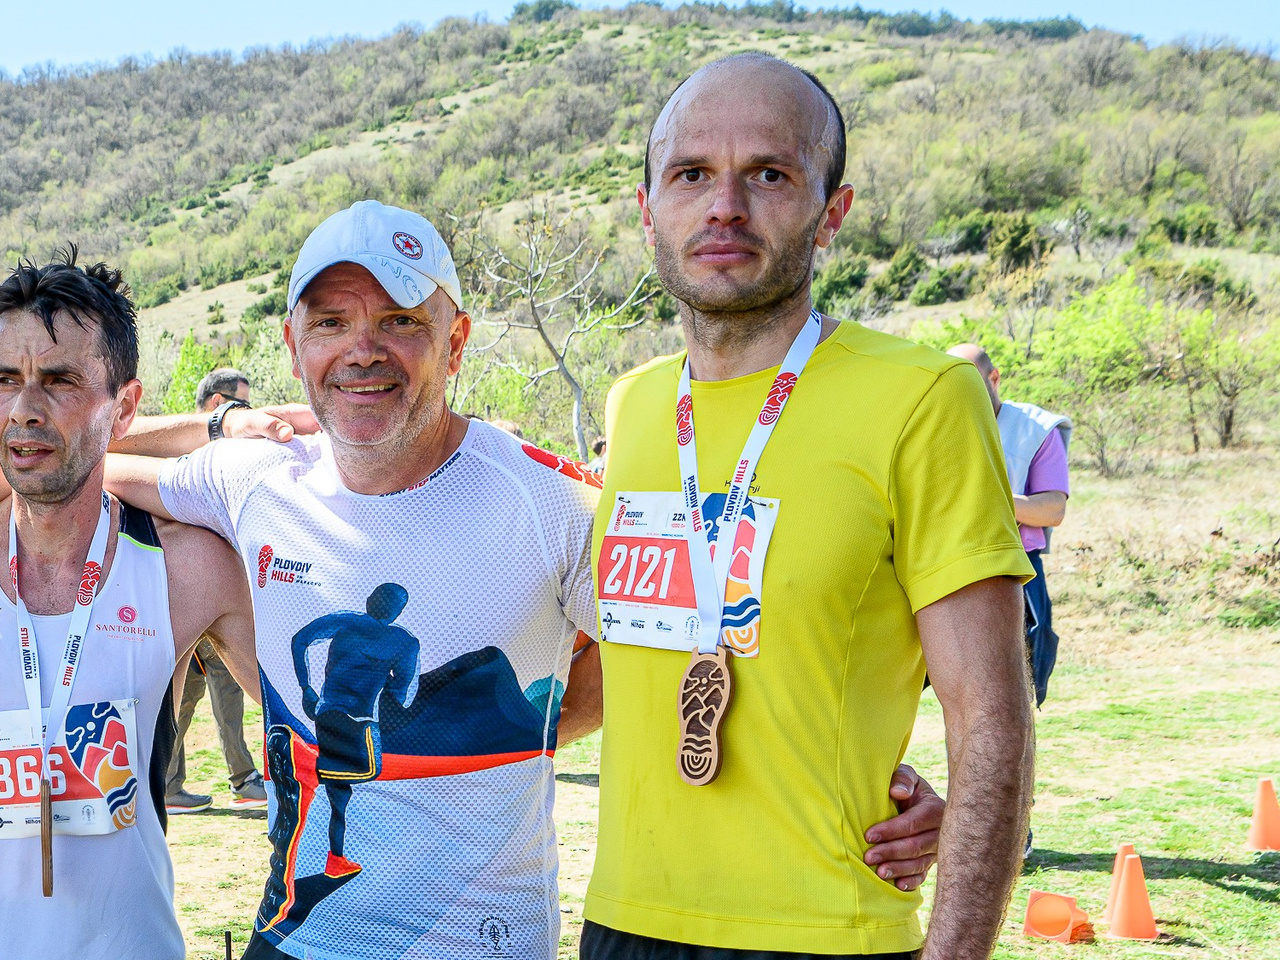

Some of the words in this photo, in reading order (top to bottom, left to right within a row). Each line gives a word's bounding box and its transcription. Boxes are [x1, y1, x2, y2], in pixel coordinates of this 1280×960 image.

[687, 474, 699, 508] PLOVDIV
[723, 485, 740, 522] PLOVDIV
[734, 459, 749, 483] HILLS
[691, 508, 702, 532] HILLS
[271, 569, 296, 583] HILLS
[274, 557, 313, 573] PLOVDIV
[603, 543, 677, 600] 2121
[20, 627, 30, 647] HILLS
[95, 623, 157, 637] SANTORELLI
[67, 634, 82, 666] PLOVDIV
[22, 649, 33, 680] PLOVDIV
[62, 665, 75, 687] HILLS
